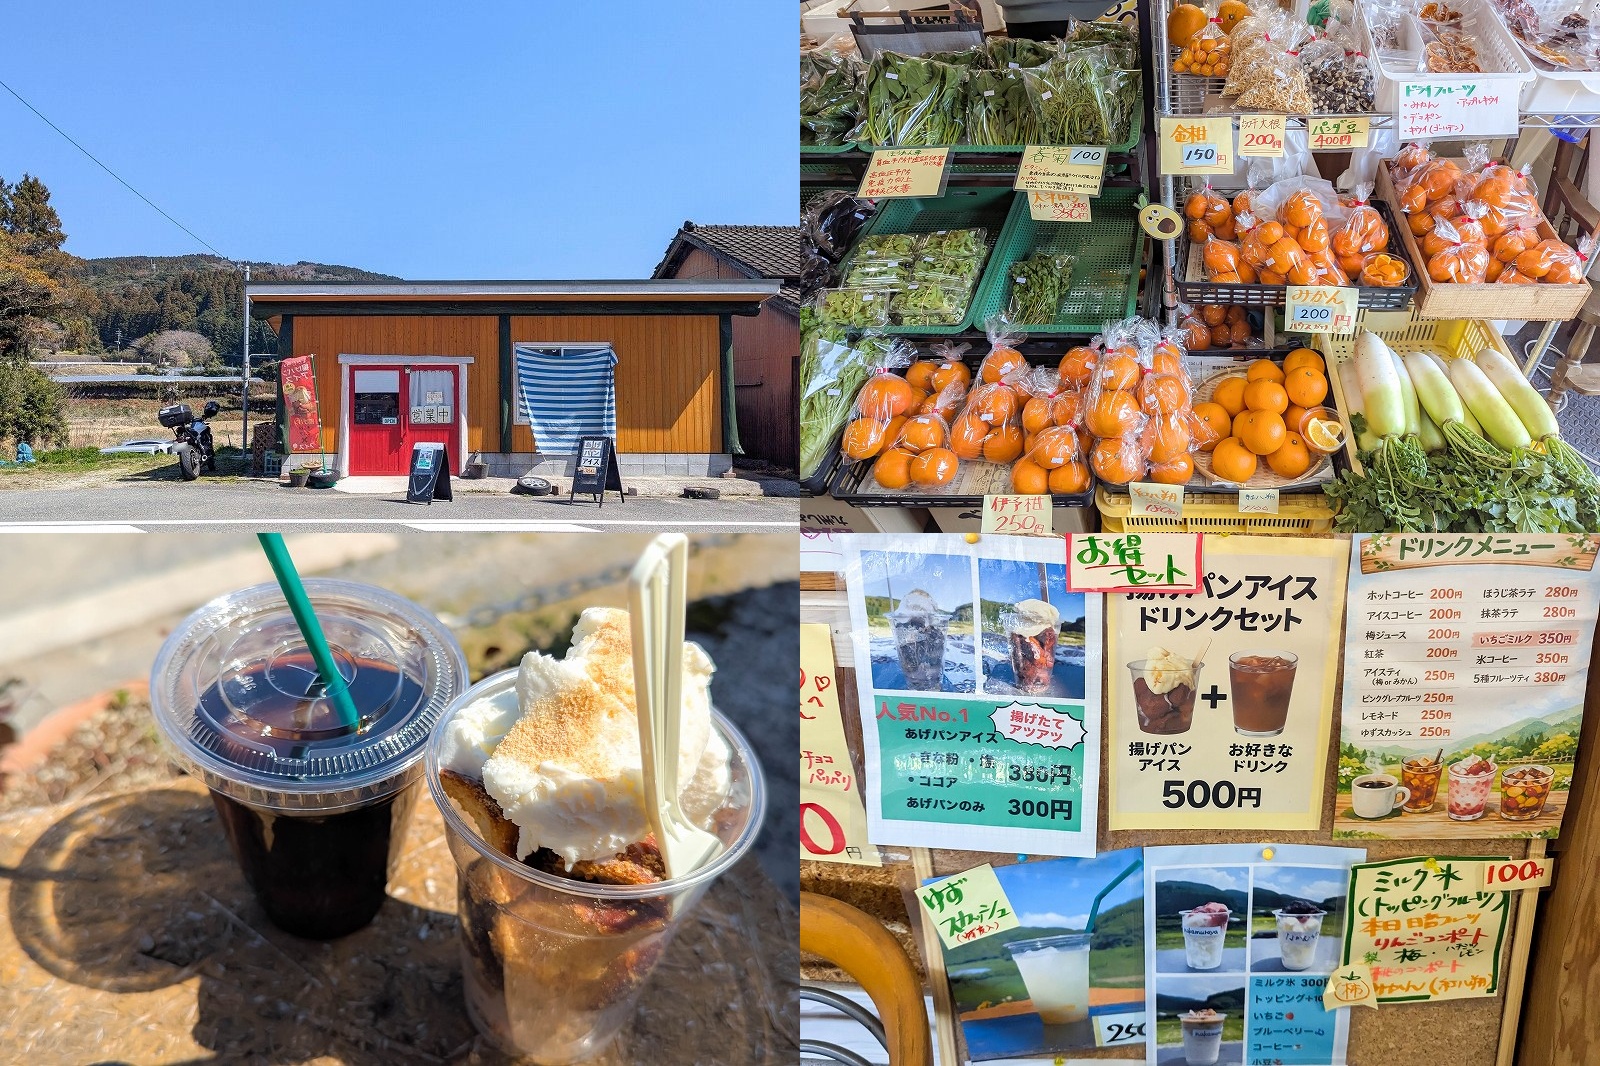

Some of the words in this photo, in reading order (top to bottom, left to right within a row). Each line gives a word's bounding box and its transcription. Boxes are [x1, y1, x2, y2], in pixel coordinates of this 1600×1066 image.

[1406, 85, 1476, 97] ドライフルーツ
[1170, 124, 1207, 143] 金柑
[1312, 119, 1358, 134] パンダ豆
[1244, 134, 1282, 149] 200円
[1314, 135, 1352, 148] 400円
[1073, 151, 1101, 160] 100
[1291, 290, 1344, 305] みかん
[412, 408, 448, 423] 営業中
[582, 458, 600, 466] アイス
[991, 496, 1044, 512] 伊予柑
[995, 514, 1045, 533] 250円
[1077, 535, 1144, 566] お得
[1399, 535, 1555, 560] ドリンクメニュー
[1110, 554, 1187, 585] セット
[1367, 590, 1424, 600] ホットコーヒー
[1430, 588, 1462, 599] 200円
[1483, 588, 1536, 598] ほうじ茶ラテ
[1544, 587, 1578, 597] 280円
[1140, 606, 1303, 631] ドリンクセット
[1367, 611, 1423, 620] アイスコーヒー
[1429, 609, 1461, 620] 200円
[1481, 608, 1519, 618] 抹茶ラテ
[1543, 607, 1575, 617] 280円
[1365, 630, 1407, 640] 梅ジュース
[1428, 629, 1460, 639] 200円
[1480, 634, 1532, 644] いちごミルク
[1538, 633, 1572, 644] 350円
[1364, 649, 1384, 659] 紅茶
[1426, 648, 1457, 658] 200円
[1476, 655, 1517, 664] 氷コーヒー
[1536, 653, 1568, 664] 350円
[1364, 668, 1400, 677] アイスティ
[1424, 670, 1455, 681] 250円
[1473, 673, 1530, 684] 5種フルーツティ
[1534, 672, 1566, 683] 380円
[1423, 693, 1453, 703] 250円
[876, 701, 969, 724] 人気No.1
[1362, 711, 1398, 720] レモネード
[1421, 710, 1451, 720] 250円
[1010, 710, 1065, 730] 揚げたて
[905, 728, 998, 744] あげパンアイス
[1009, 724, 1063, 742] アツアツ
[1361, 728, 1412, 737] ゆずスカッシュ
[1420, 727, 1450, 737] 250円
[1129, 742, 1192, 757] 揚げパン
[1229, 743, 1293, 757] お好きな
[804, 751, 834, 769] チョコ
[1138, 759, 1181, 772] アイス
[1234, 760, 1288, 773] ドリンク
[919, 776, 957, 788] ココア
[1162, 780, 1262, 808] 500円
[906, 797, 985, 813] あげパンのみ
[1008, 799, 1073, 820] 300円
[1373, 864, 1463, 892] ミルク氷
[1487, 861, 1544, 885] 100円
[922, 877, 967, 913] ゆず
[939, 900, 1011, 937] スカッシュ
[1255, 978, 1296, 987] ミルク氷
[1253, 1012, 1284, 1020] いちご
[1253, 1027, 1313, 1036] ブルーベリー
[1253, 1042, 1292, 1051] コーヒー
